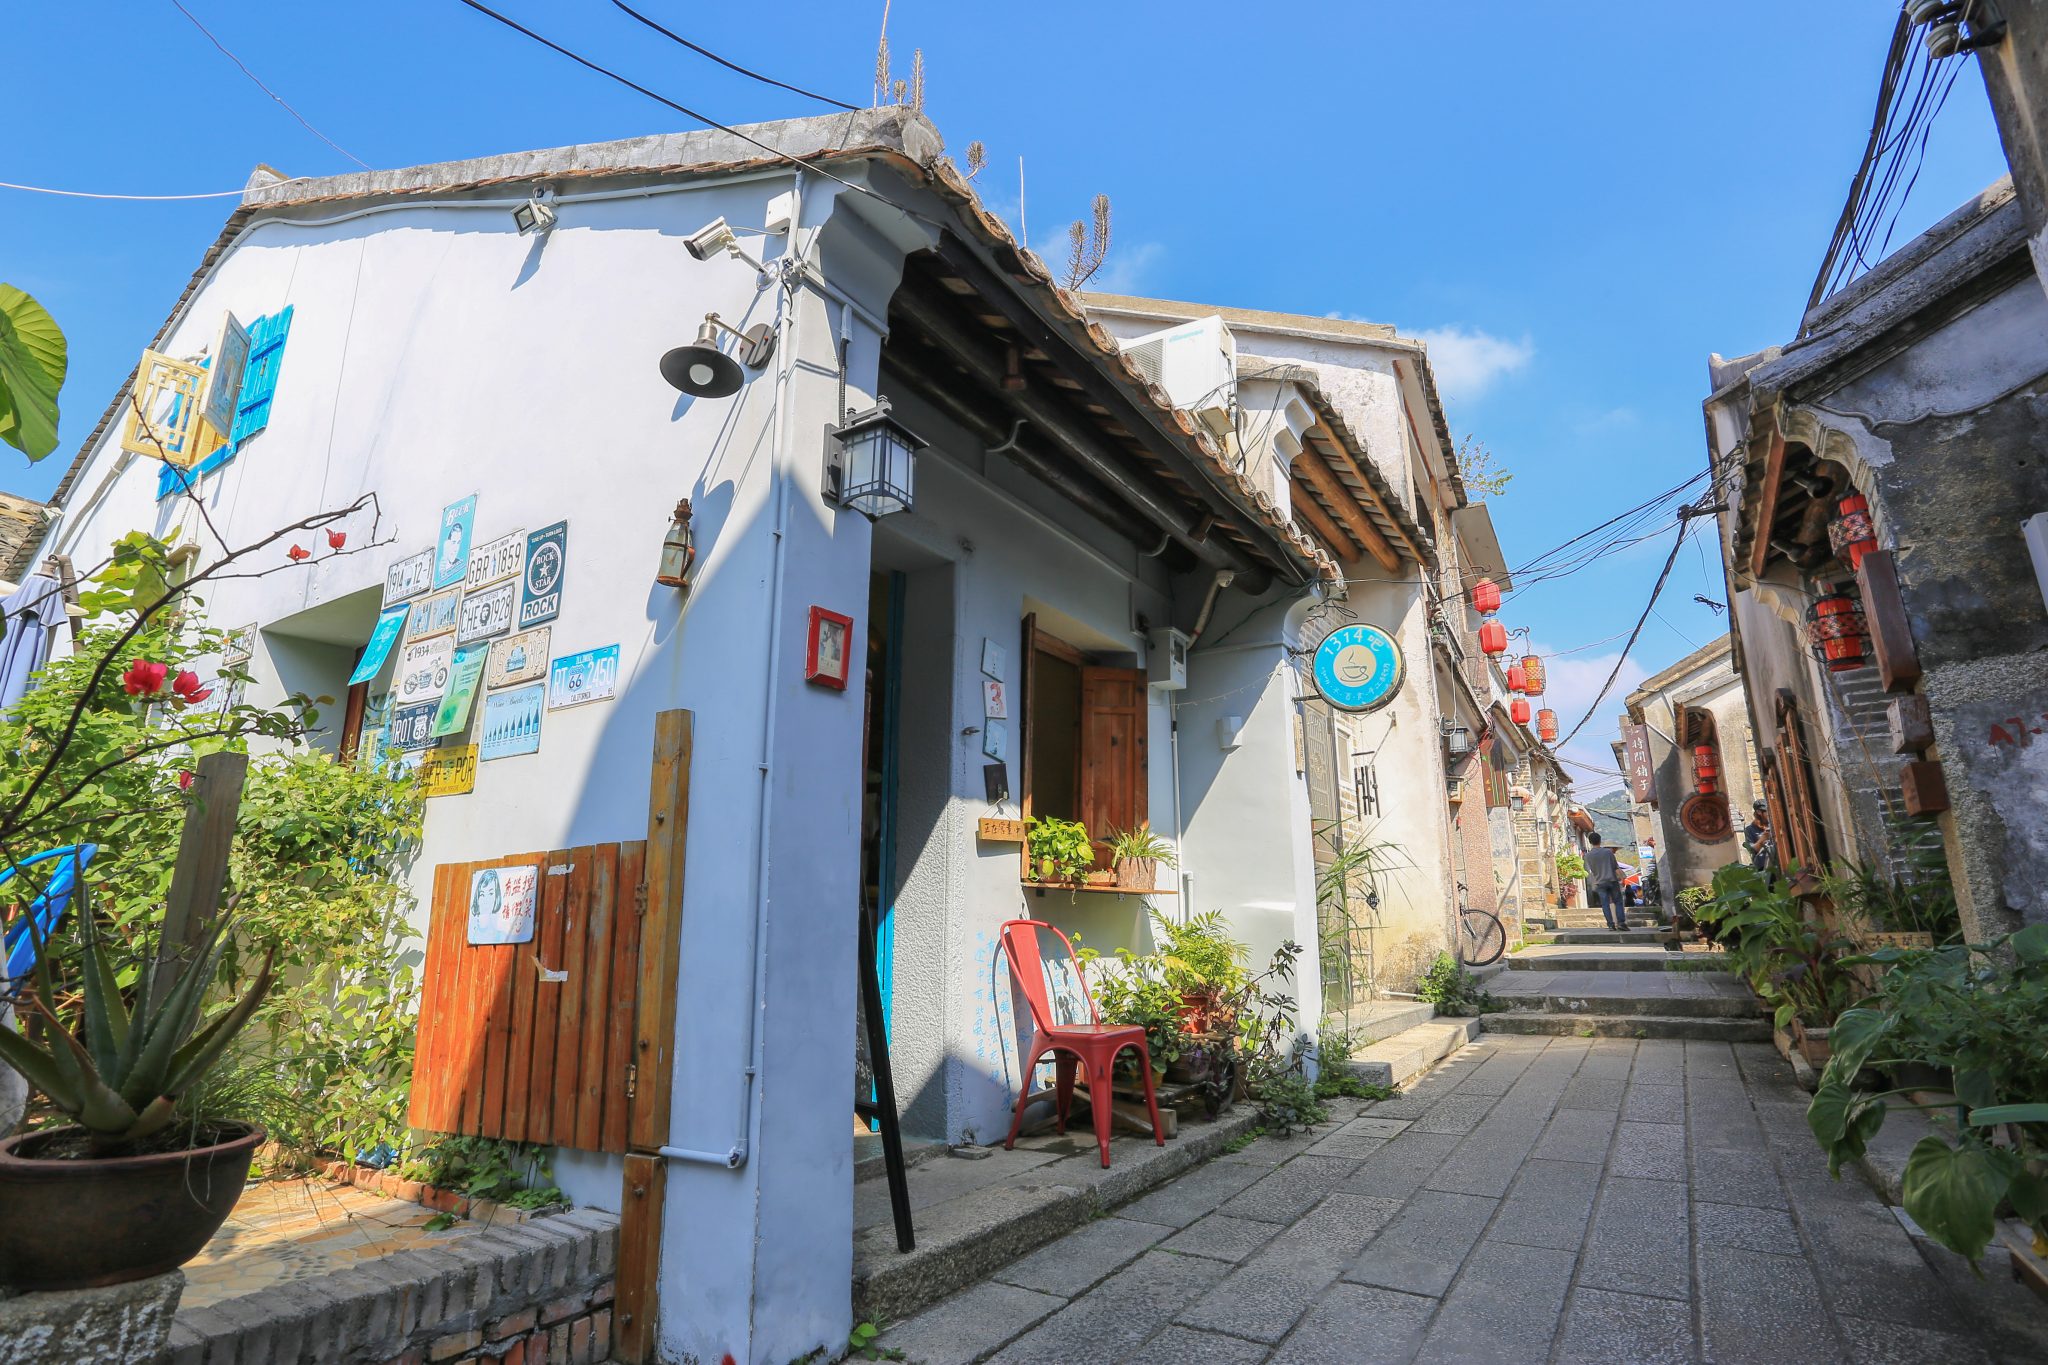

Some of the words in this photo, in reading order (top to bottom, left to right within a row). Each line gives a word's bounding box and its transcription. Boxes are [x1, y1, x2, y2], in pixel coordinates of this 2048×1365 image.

[468, 555, 489, 585] GBR
[497, 542, 521, 575] 1859
[535, 550, 555, 566] ROCK
[388, 568, 404, 595] 1914
[535, 576, 552, 590] STAR
[461, 604, 480, 633] CHE
[490, 594, 511, 625] 1928
[524, 594, 556, 620] ROCK
[414, 644, 430, 658] 1934
[1324, 628, 1385, 655] 1314吧
[553, 667, 568, 696] RT
[569, 674, 582, 689] 66
[586, 656, 615, 690] 2450
[415, 725, 426, 737] 66
[454, 755, 475, 784] POR
